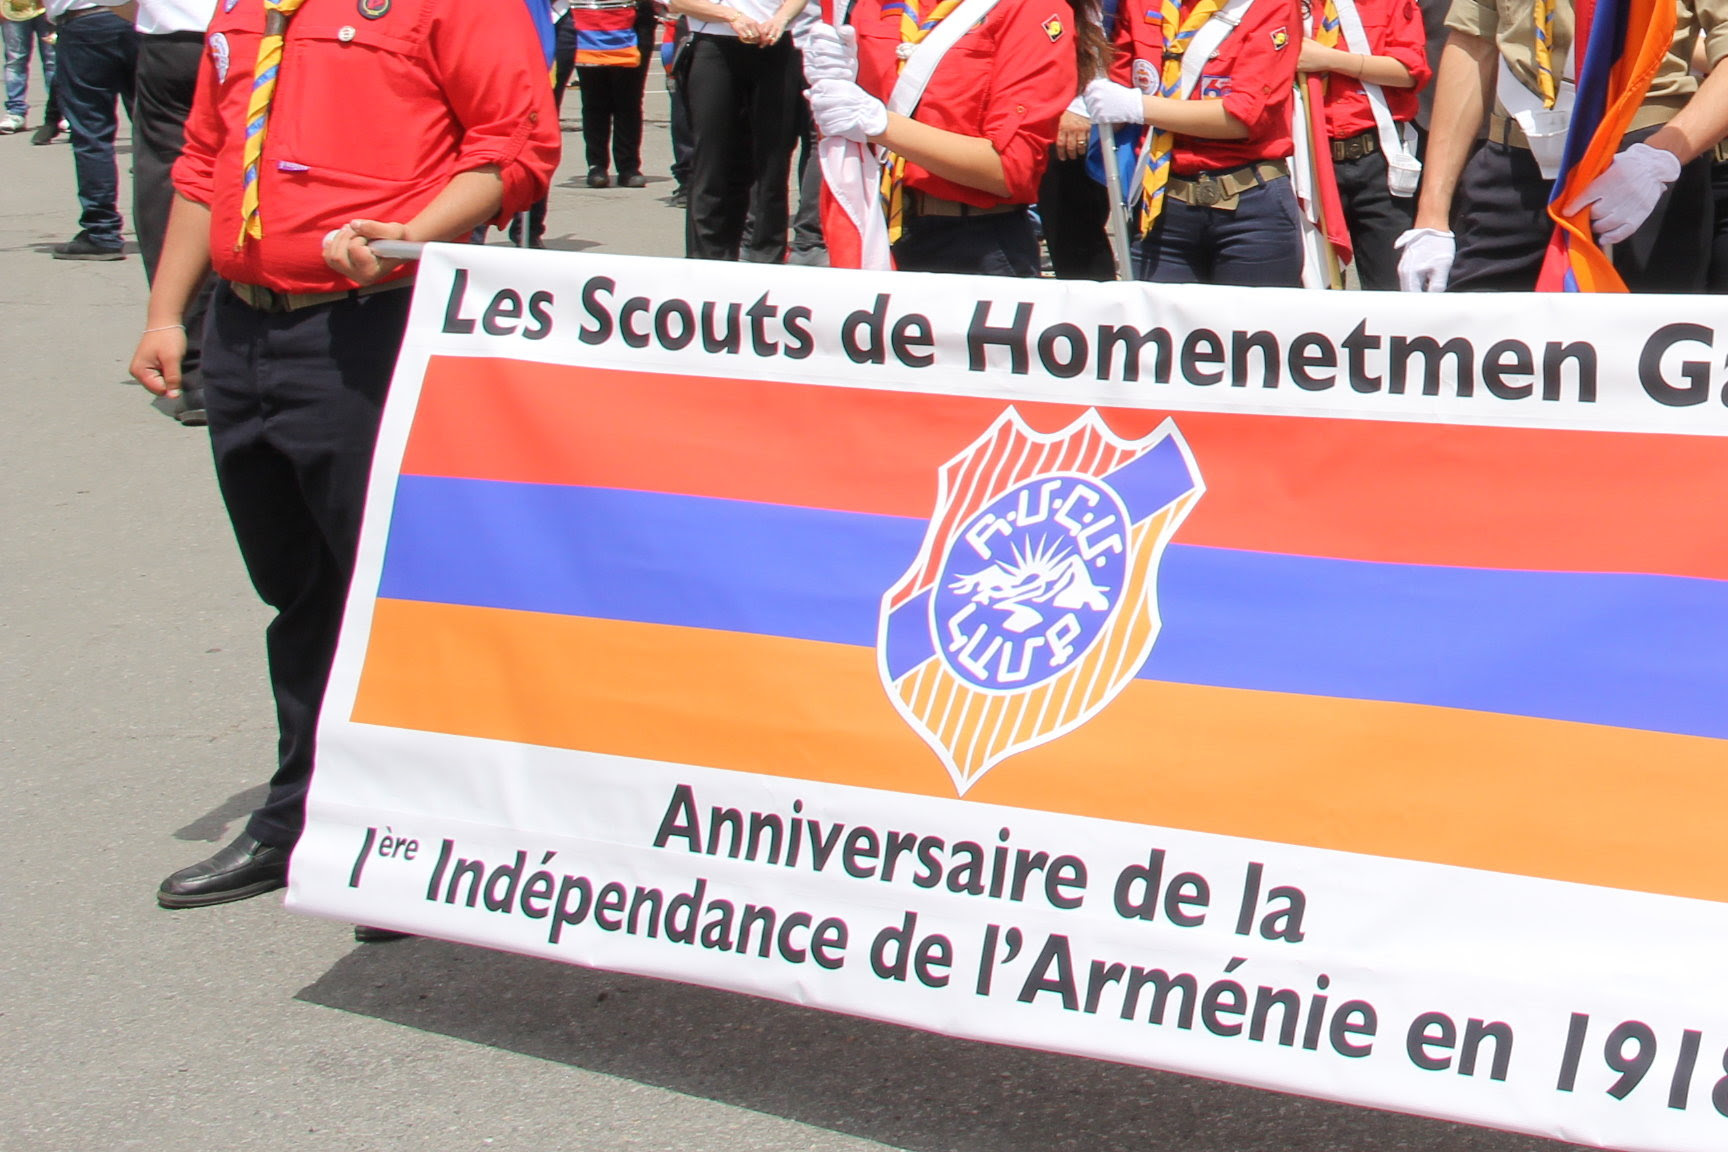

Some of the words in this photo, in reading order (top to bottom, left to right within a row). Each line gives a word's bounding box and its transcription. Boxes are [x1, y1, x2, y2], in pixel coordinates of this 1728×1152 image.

[441, 267, 554, 341] Les
[577, 275, 815, 361] Scouts
[840, 292, 936, 369] de
[965, 299, 1597, 404] Homenetmen
[652, 783, 1088, 911] Anniversaire
[1112, 848, 1211, 929] de
[1234, 861, 1307, 944] la
[425, 838, 849, 971] Indépendance
[869, 910, 954, 989] de
[1405, 1011, 1514, 1083] en
